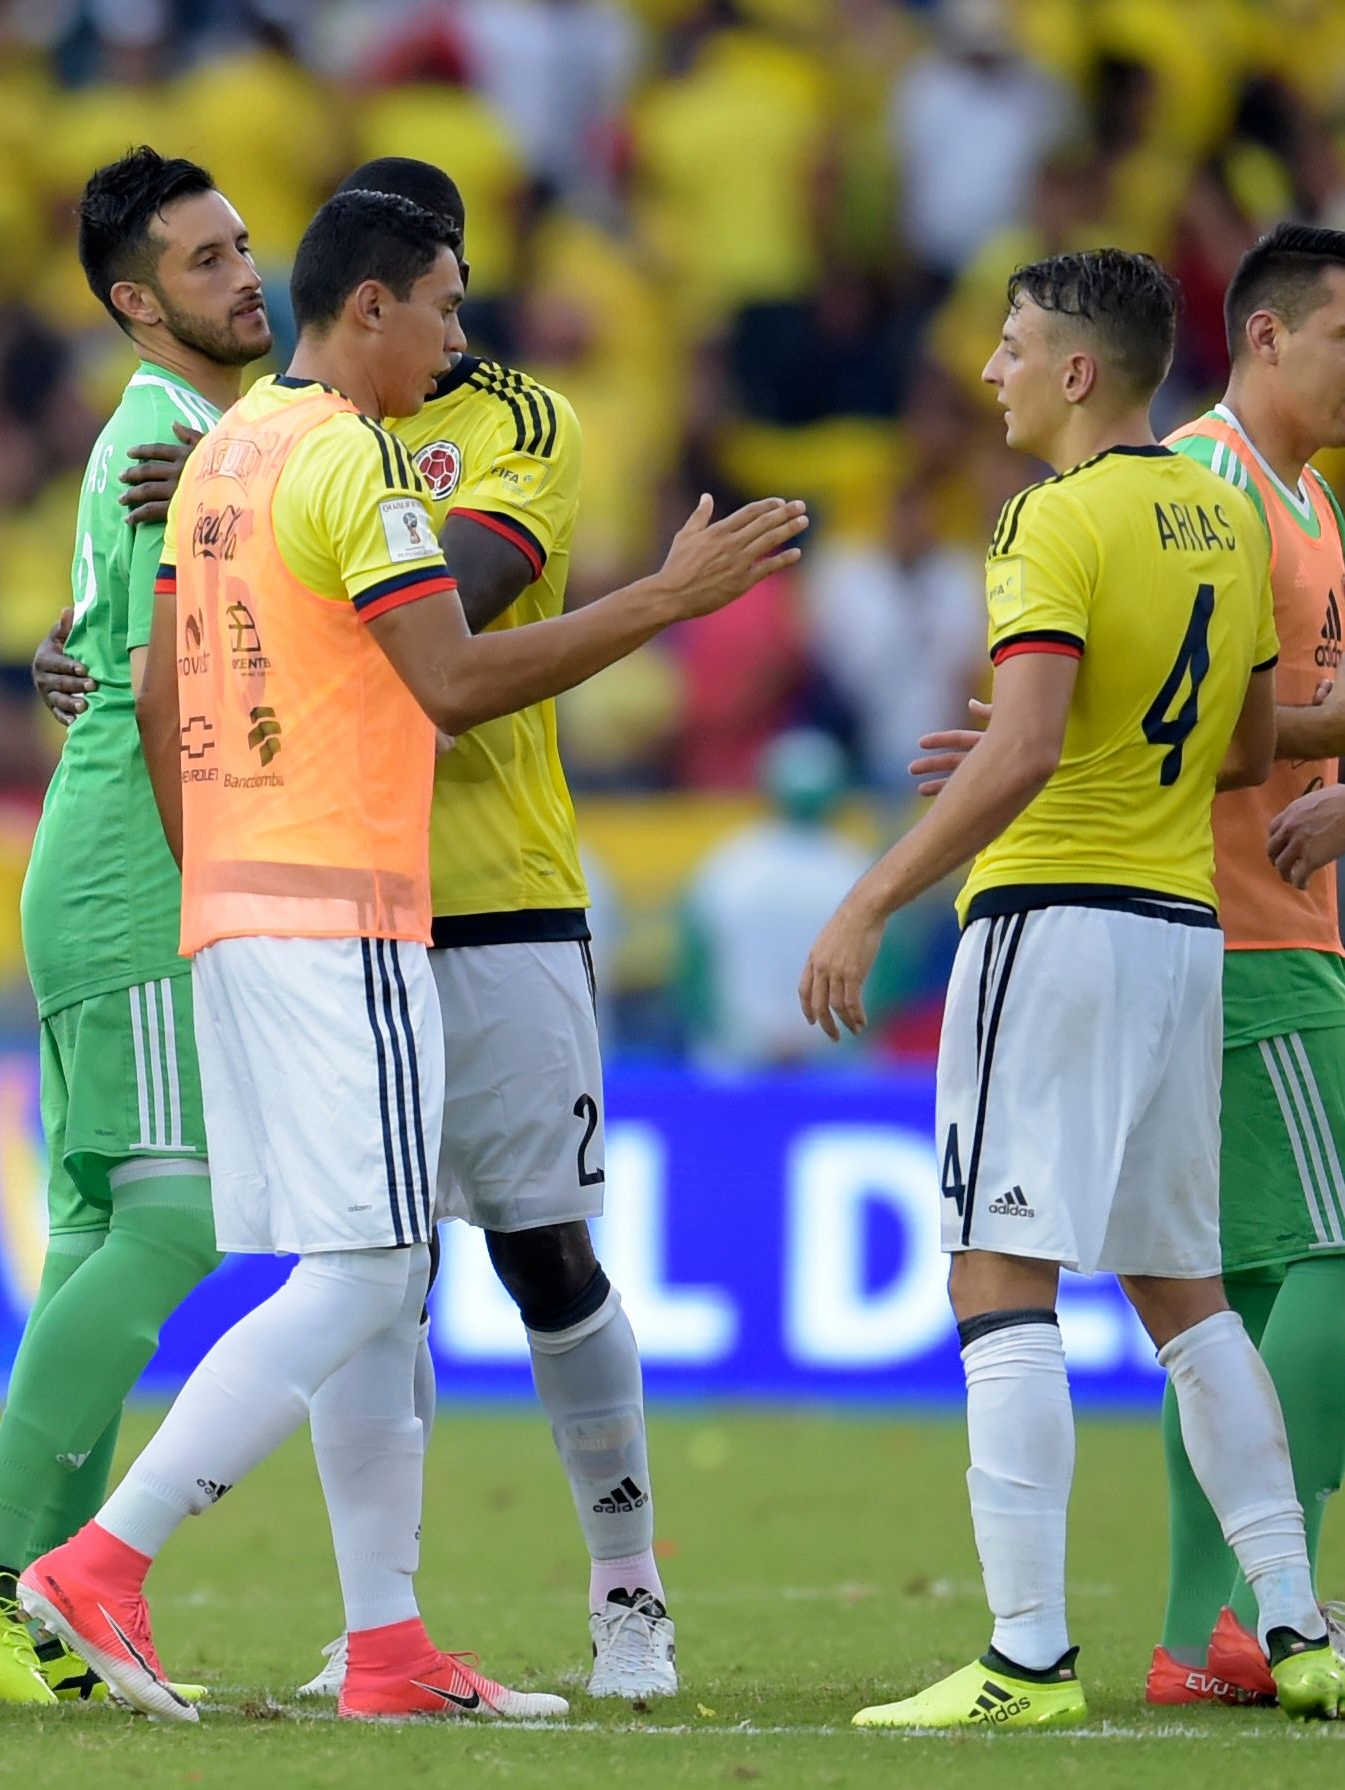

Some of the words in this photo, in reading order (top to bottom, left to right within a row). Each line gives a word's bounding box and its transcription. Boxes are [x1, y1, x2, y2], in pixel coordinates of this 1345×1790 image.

[490, 466, 519, 484] FIFA
[1155, 501, 1236, 552] ARIAS
[1142, 584, 1214, 786] 4
[573, 1092, 605, 1187] 2
[941, 1122, 966, 1217] 4
[988, 1203, 1035, 1218] adidas
[592, 1492, 649, 1514] adidas
[967, 1696, 1031, 1727] didas
